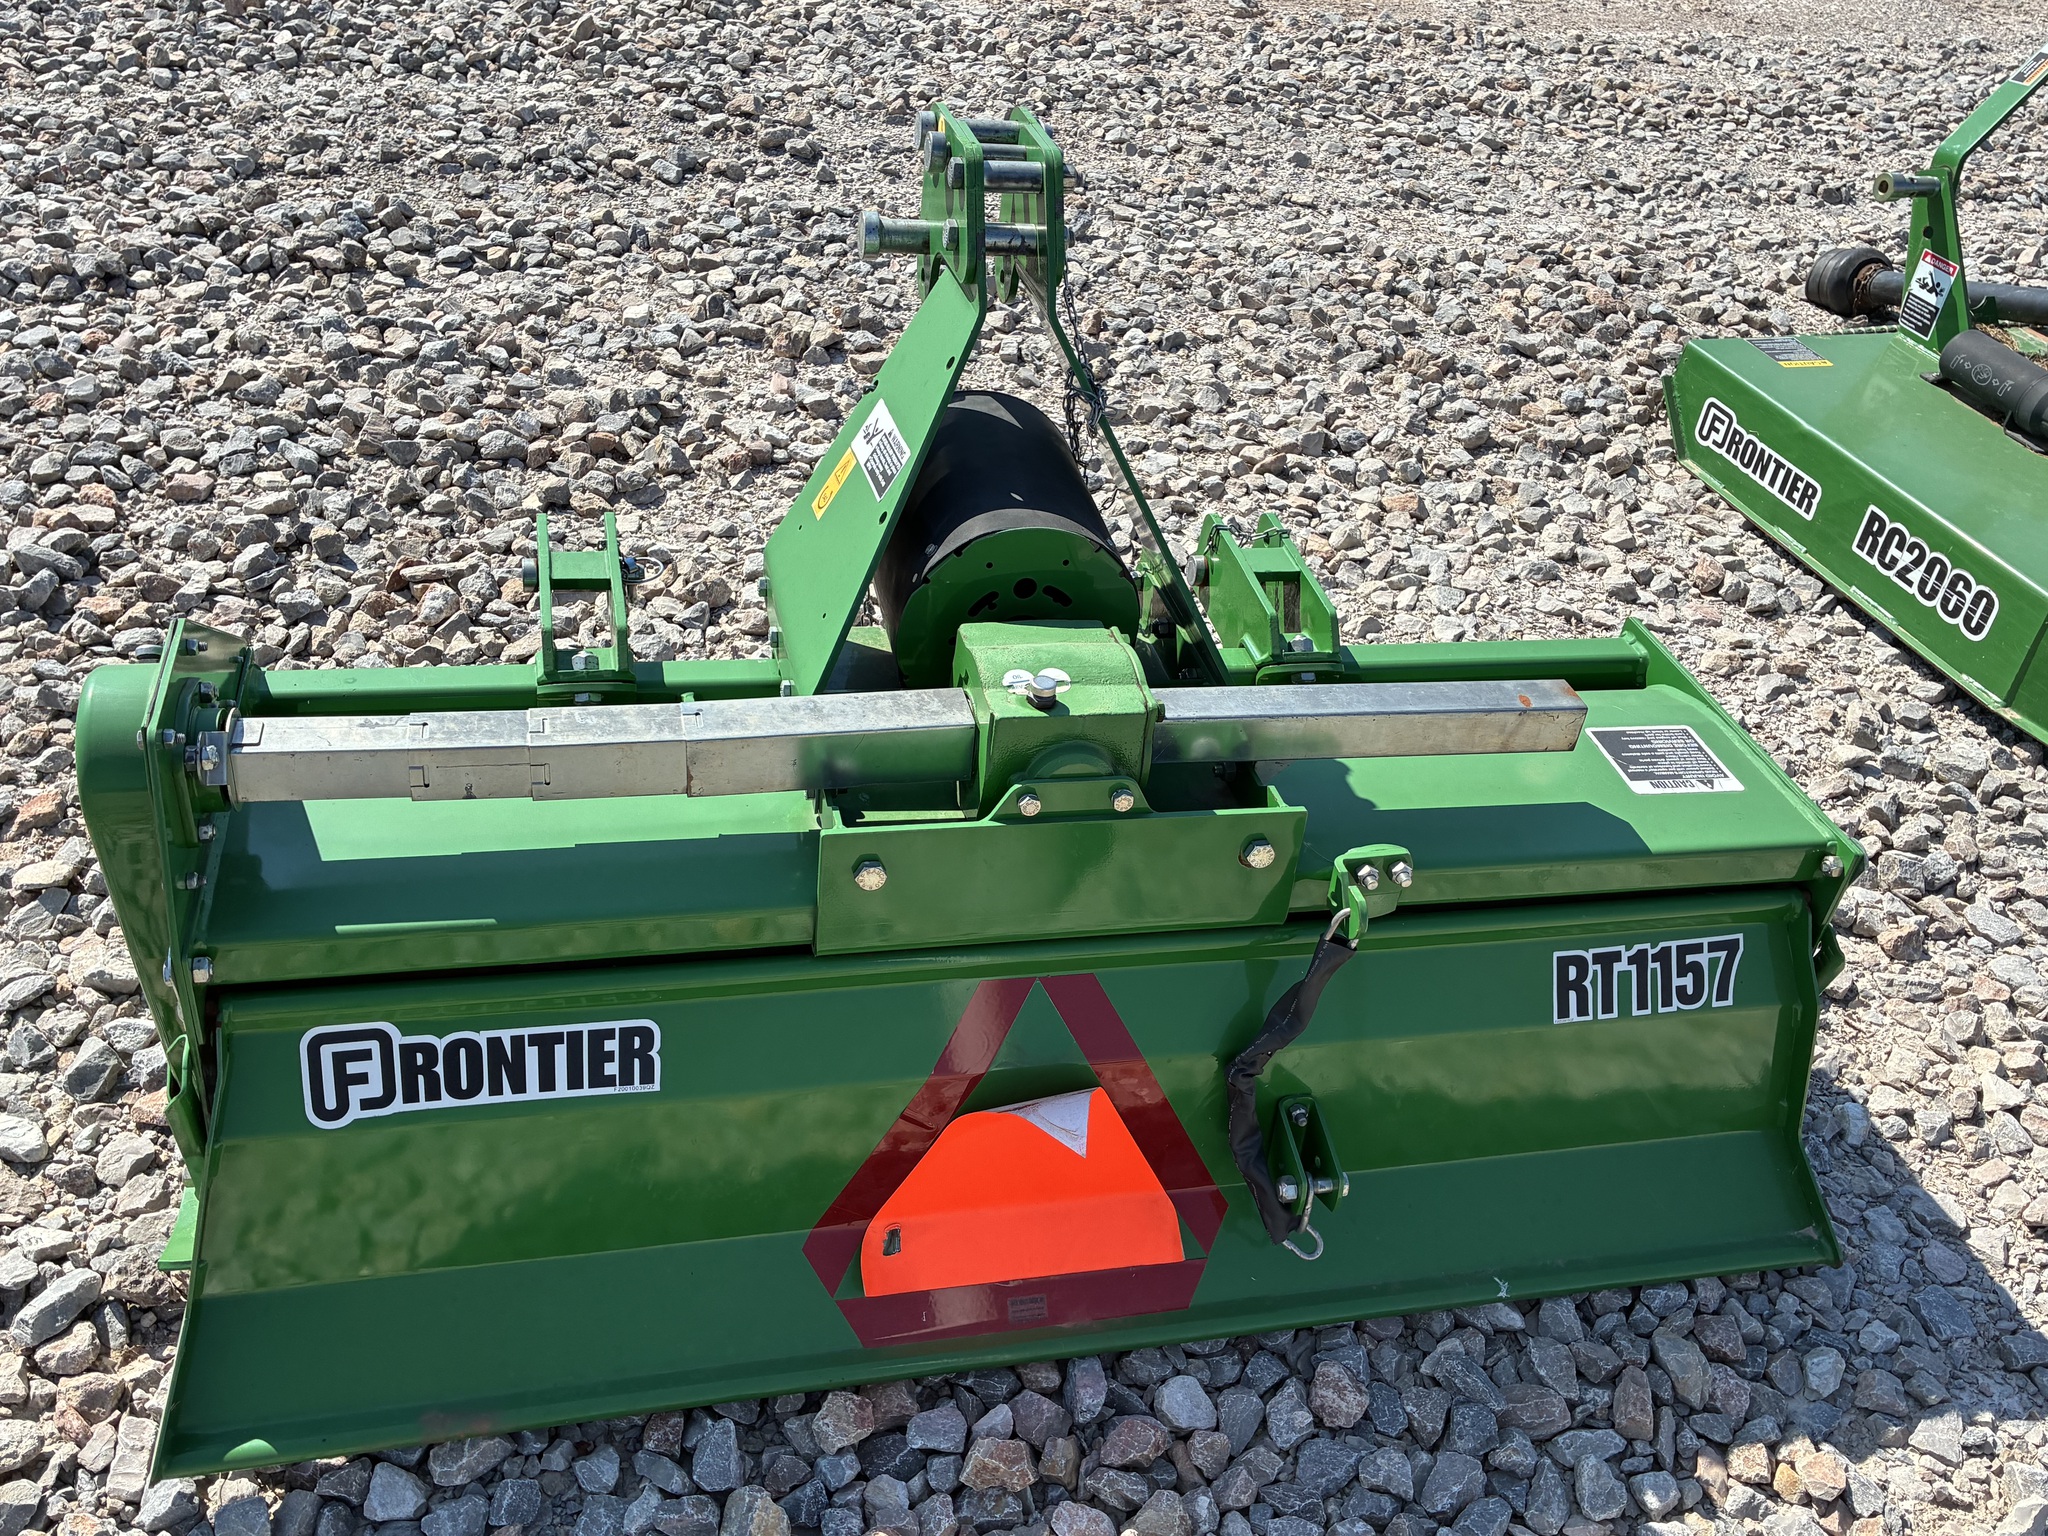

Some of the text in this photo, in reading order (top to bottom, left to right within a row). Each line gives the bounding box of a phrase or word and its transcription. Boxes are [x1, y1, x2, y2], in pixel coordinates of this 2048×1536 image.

[1930, 258, 1954, 275] DANGER
[1698, 401, 1819, 515] FRONTIER
[1856, 509, 1996, 636] RC2060
[1649, 780, 1695, 789] CAUTION
[1556, 937, 1740, 1020] RT1157
[306, 1026, 656, 1122] FRONTIER
